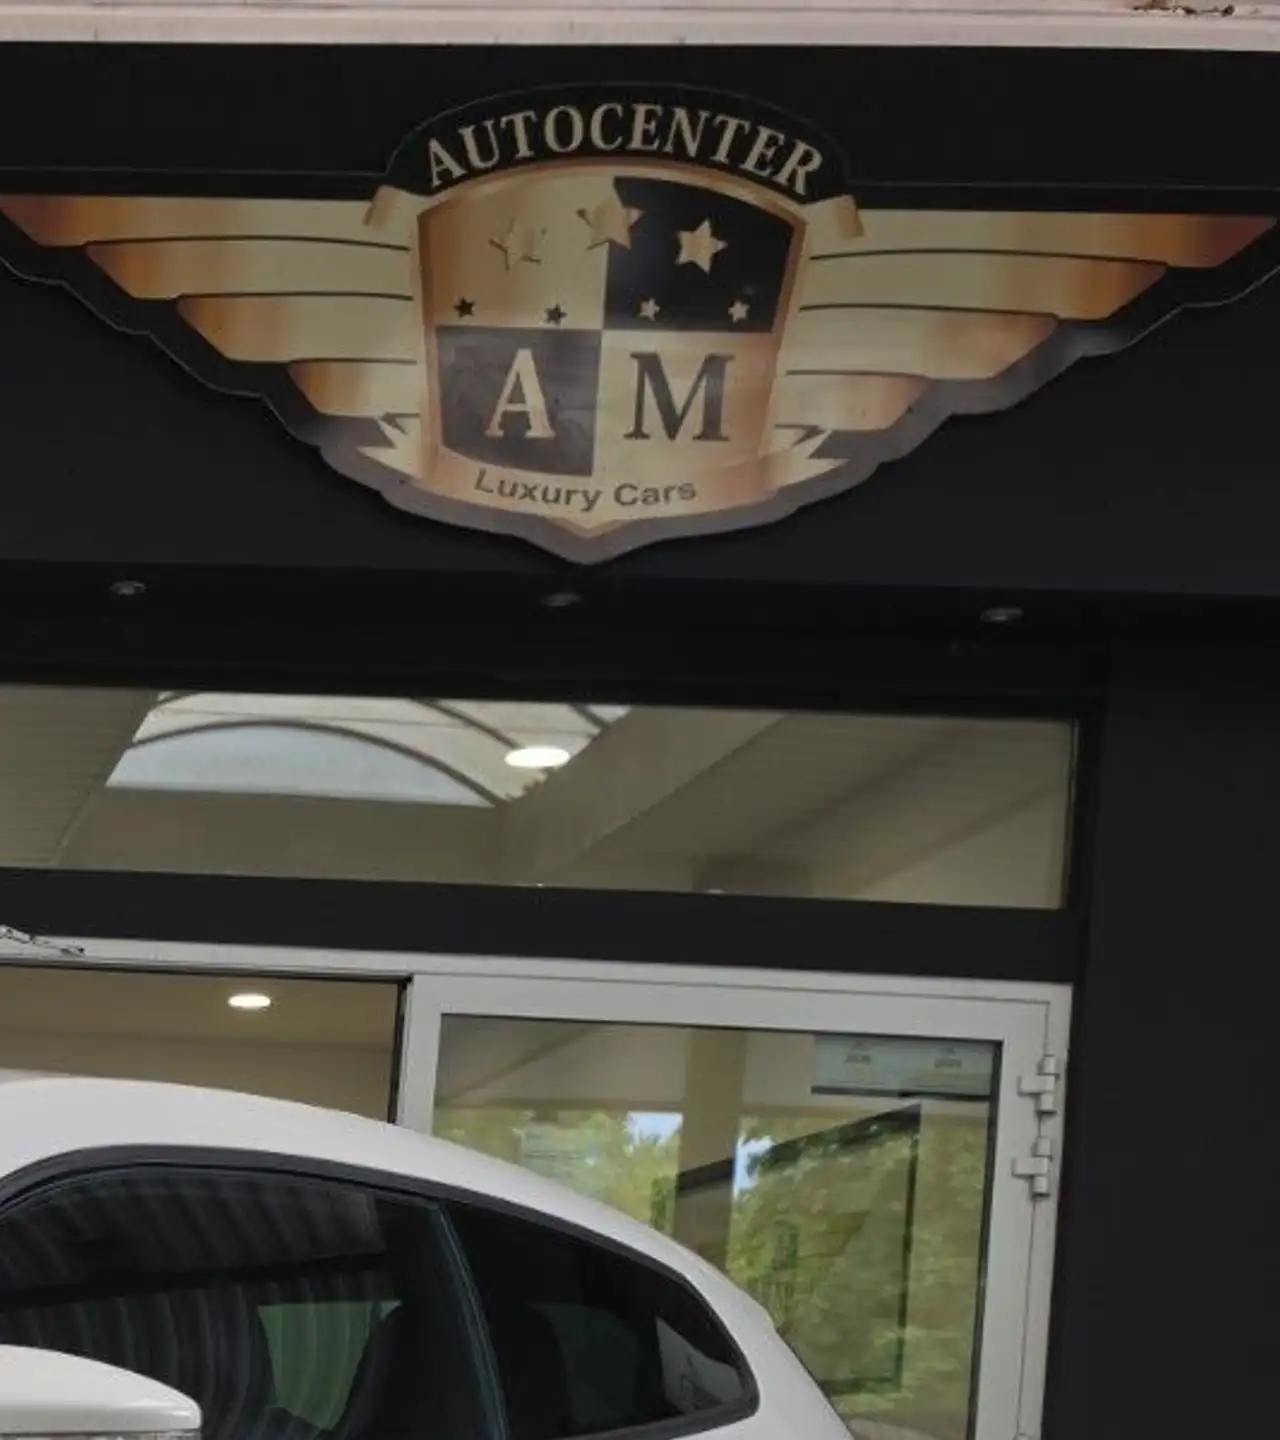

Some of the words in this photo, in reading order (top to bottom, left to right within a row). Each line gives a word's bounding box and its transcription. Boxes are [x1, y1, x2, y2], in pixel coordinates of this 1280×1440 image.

[424, 103, 823, 195] AUTOCENTER
[484, 347, 557, 440] A
[622, 351, 735, 442] M
[473, 467, 603, 513] Luxury
[613, 480, 697, 507] Cars
